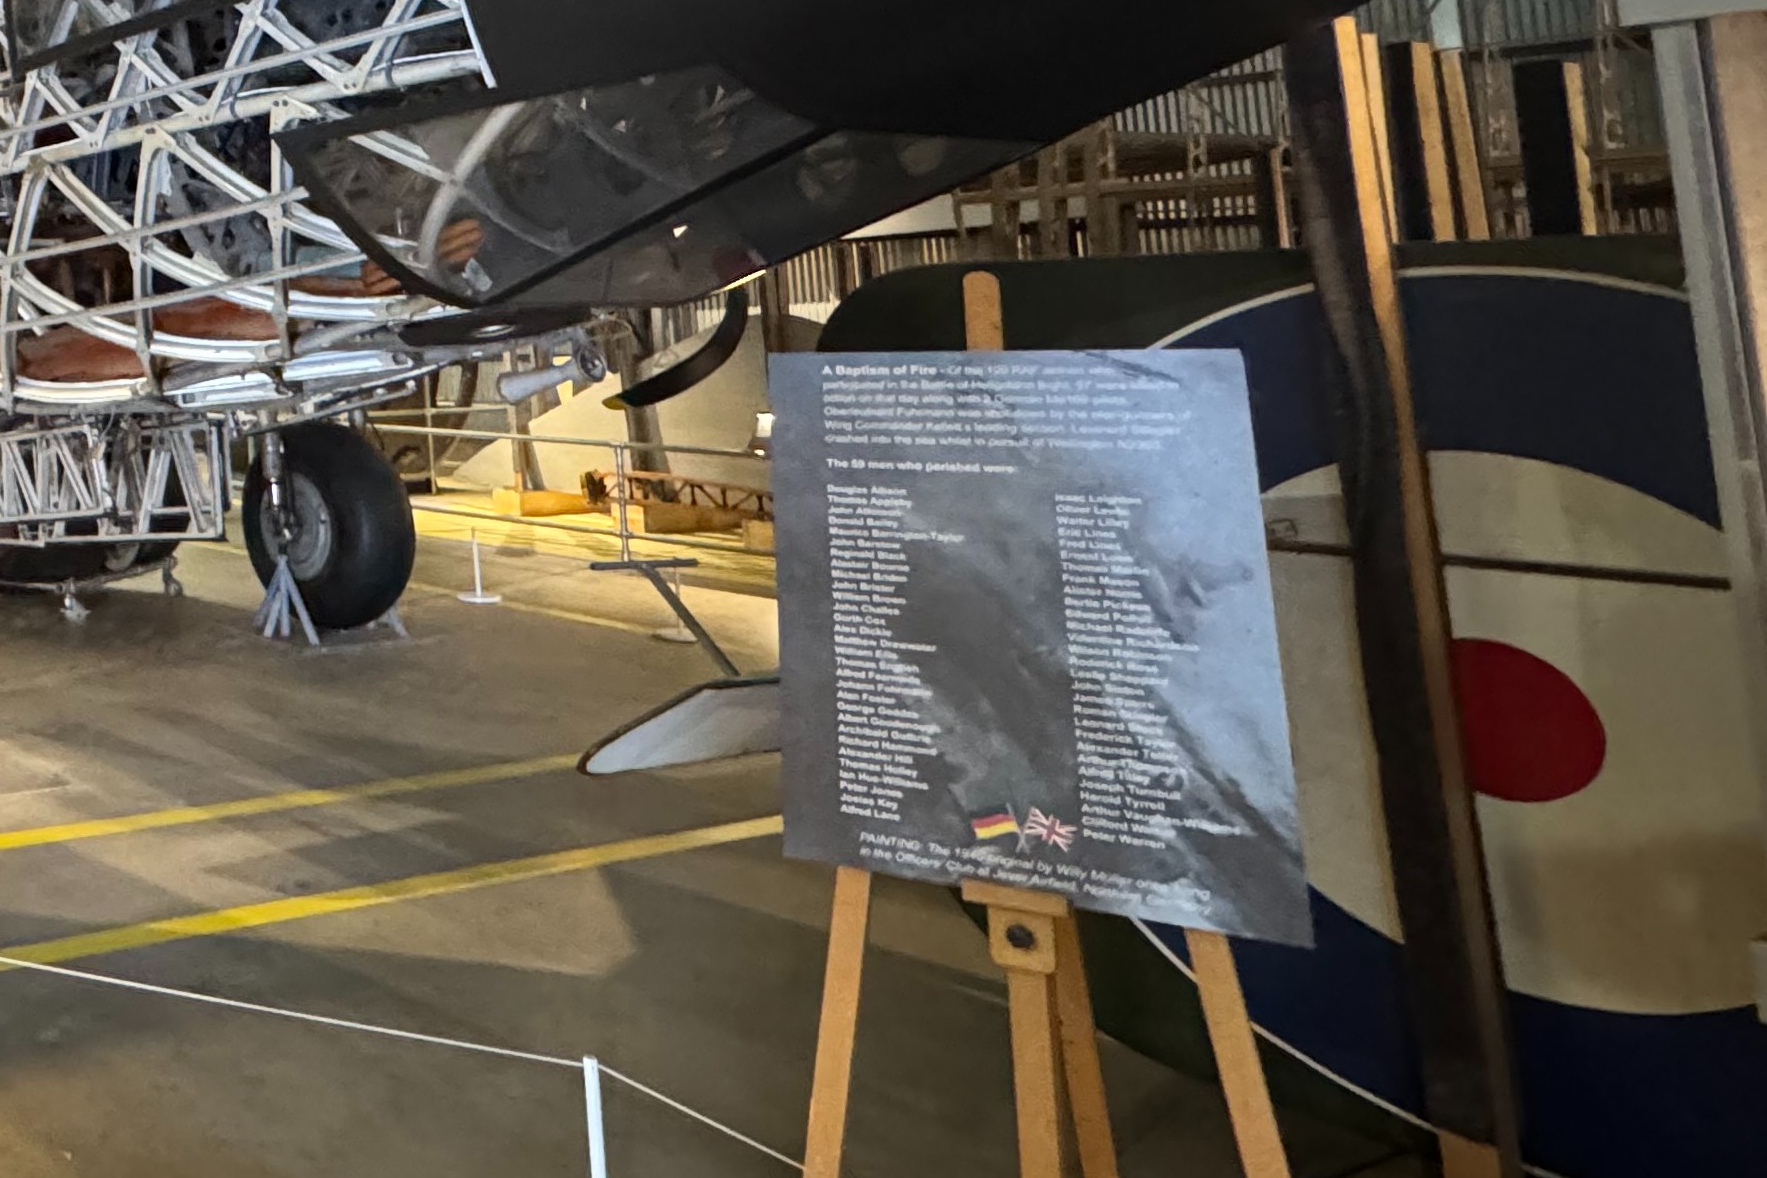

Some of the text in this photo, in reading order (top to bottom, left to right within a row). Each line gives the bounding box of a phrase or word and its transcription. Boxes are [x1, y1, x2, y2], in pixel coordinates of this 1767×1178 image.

[823, 365, 834, 375] A
[835, 365, 890, 378] Baptism
[893, 365, 907, 375] of
[910, 365, 937, 375] Fire
[827, 458, 849, 469] The
[868, 460, 894, 470] men
[896, 461, 923, 472] who
[859, 846, 872, 857] in
[873, 848, 893, 861] the
[1037, 859, 1053, 876] by
